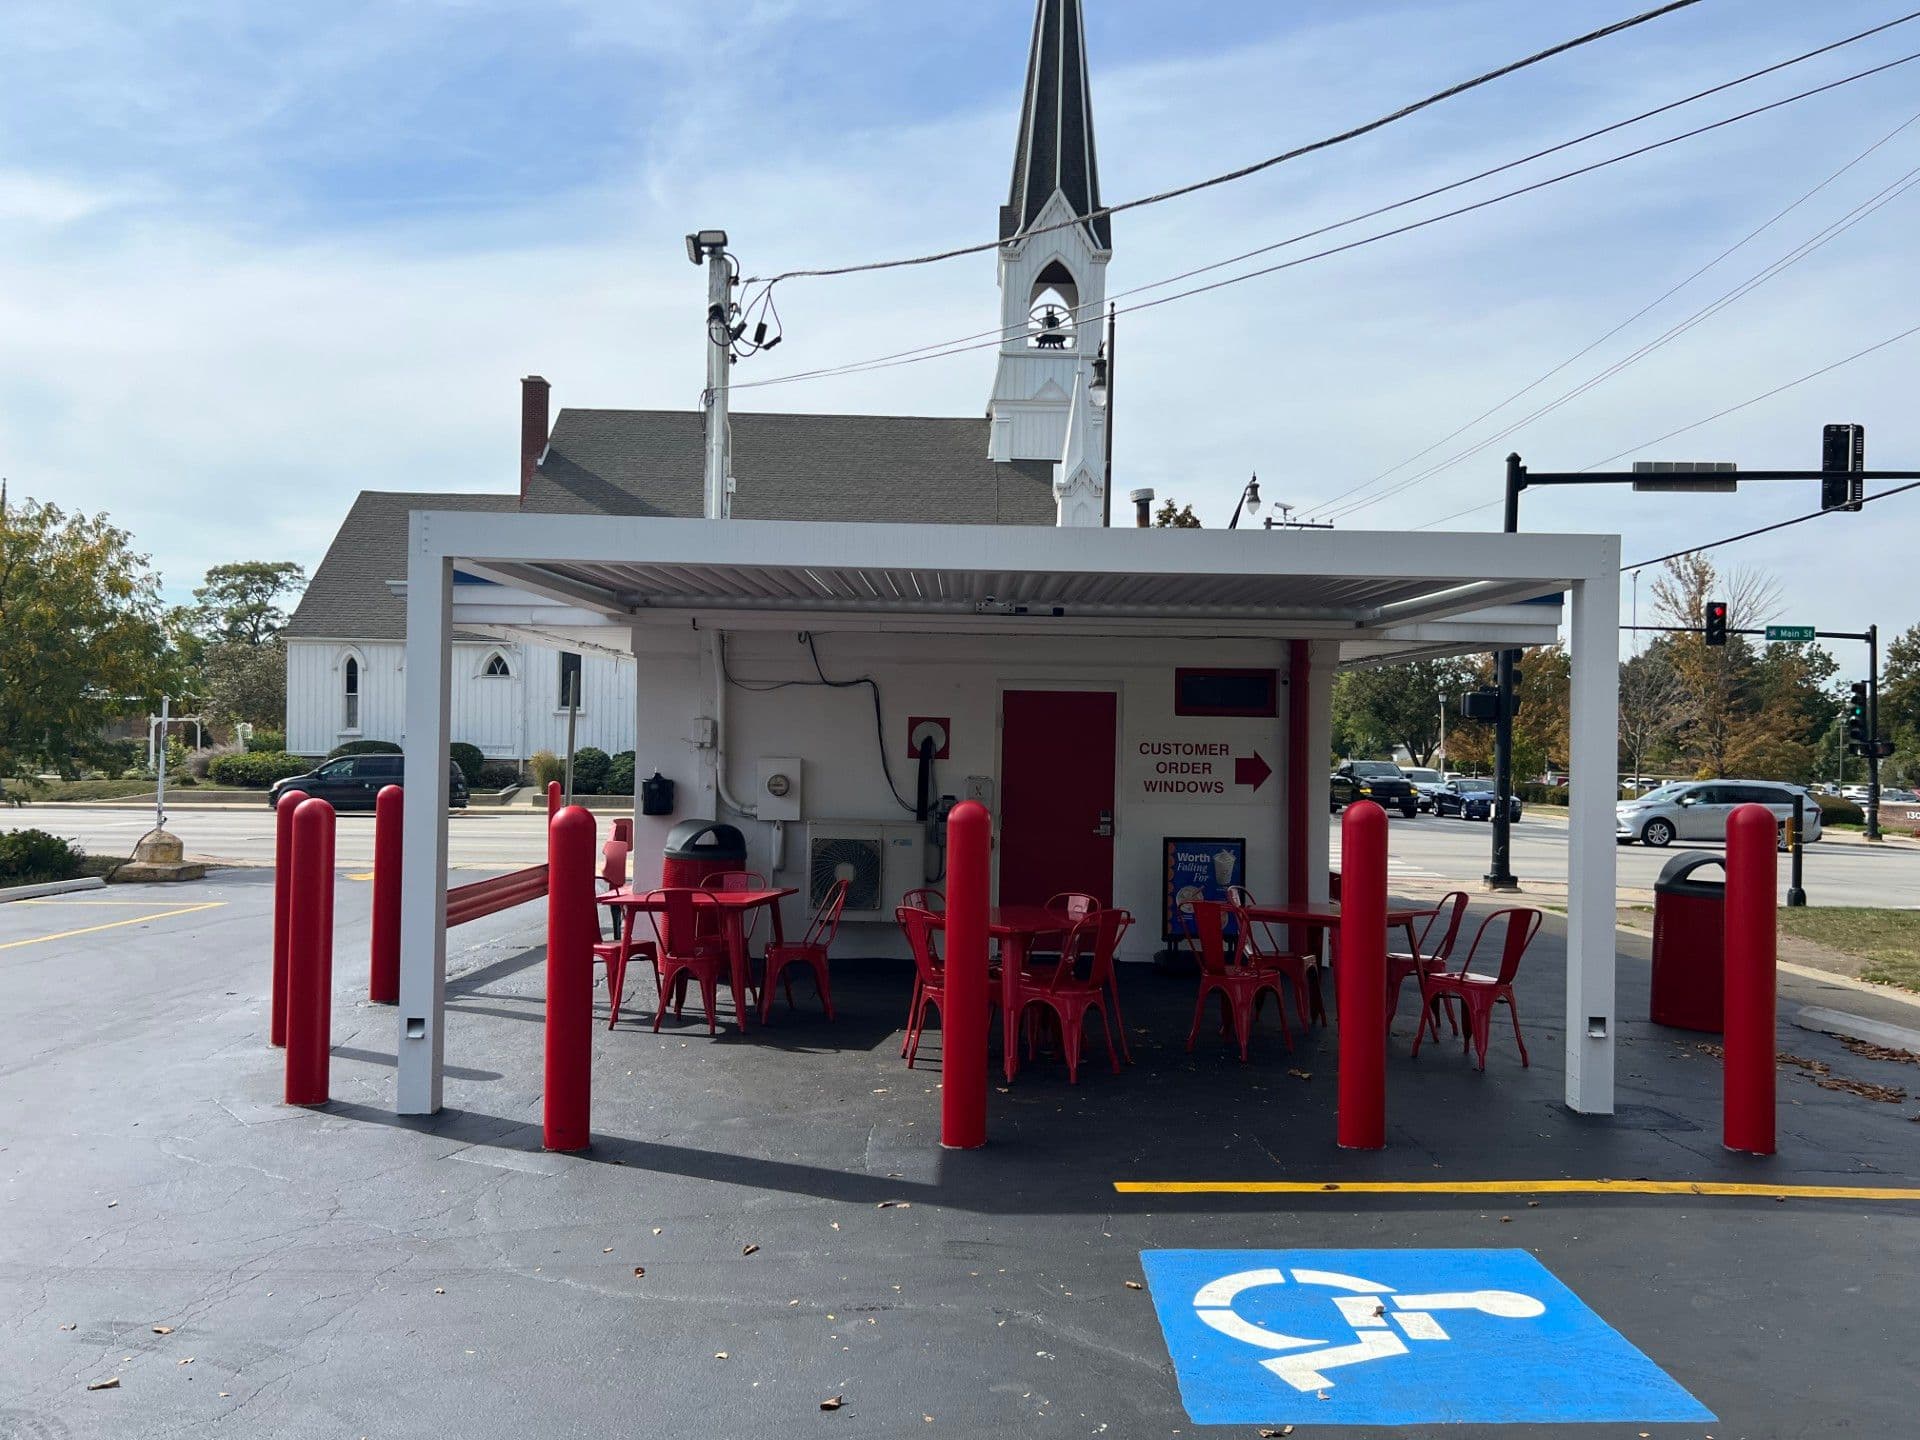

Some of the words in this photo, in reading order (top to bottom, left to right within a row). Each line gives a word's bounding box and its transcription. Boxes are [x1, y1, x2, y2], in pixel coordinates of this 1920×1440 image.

[1780, 629, 1800, 638] Main
[1803, 629, 1812, 638] St
[1139, 742, 1229, 756] CUSTOMER
[1156, 762, 1212, 774] ORDER
[1144, 780, 1224, 793] WINDOWS
[1177, 852, 1210, 863] Worth
[1177, 863, 1208, 874] Falling
[1193, 872, 1208, 882] For
